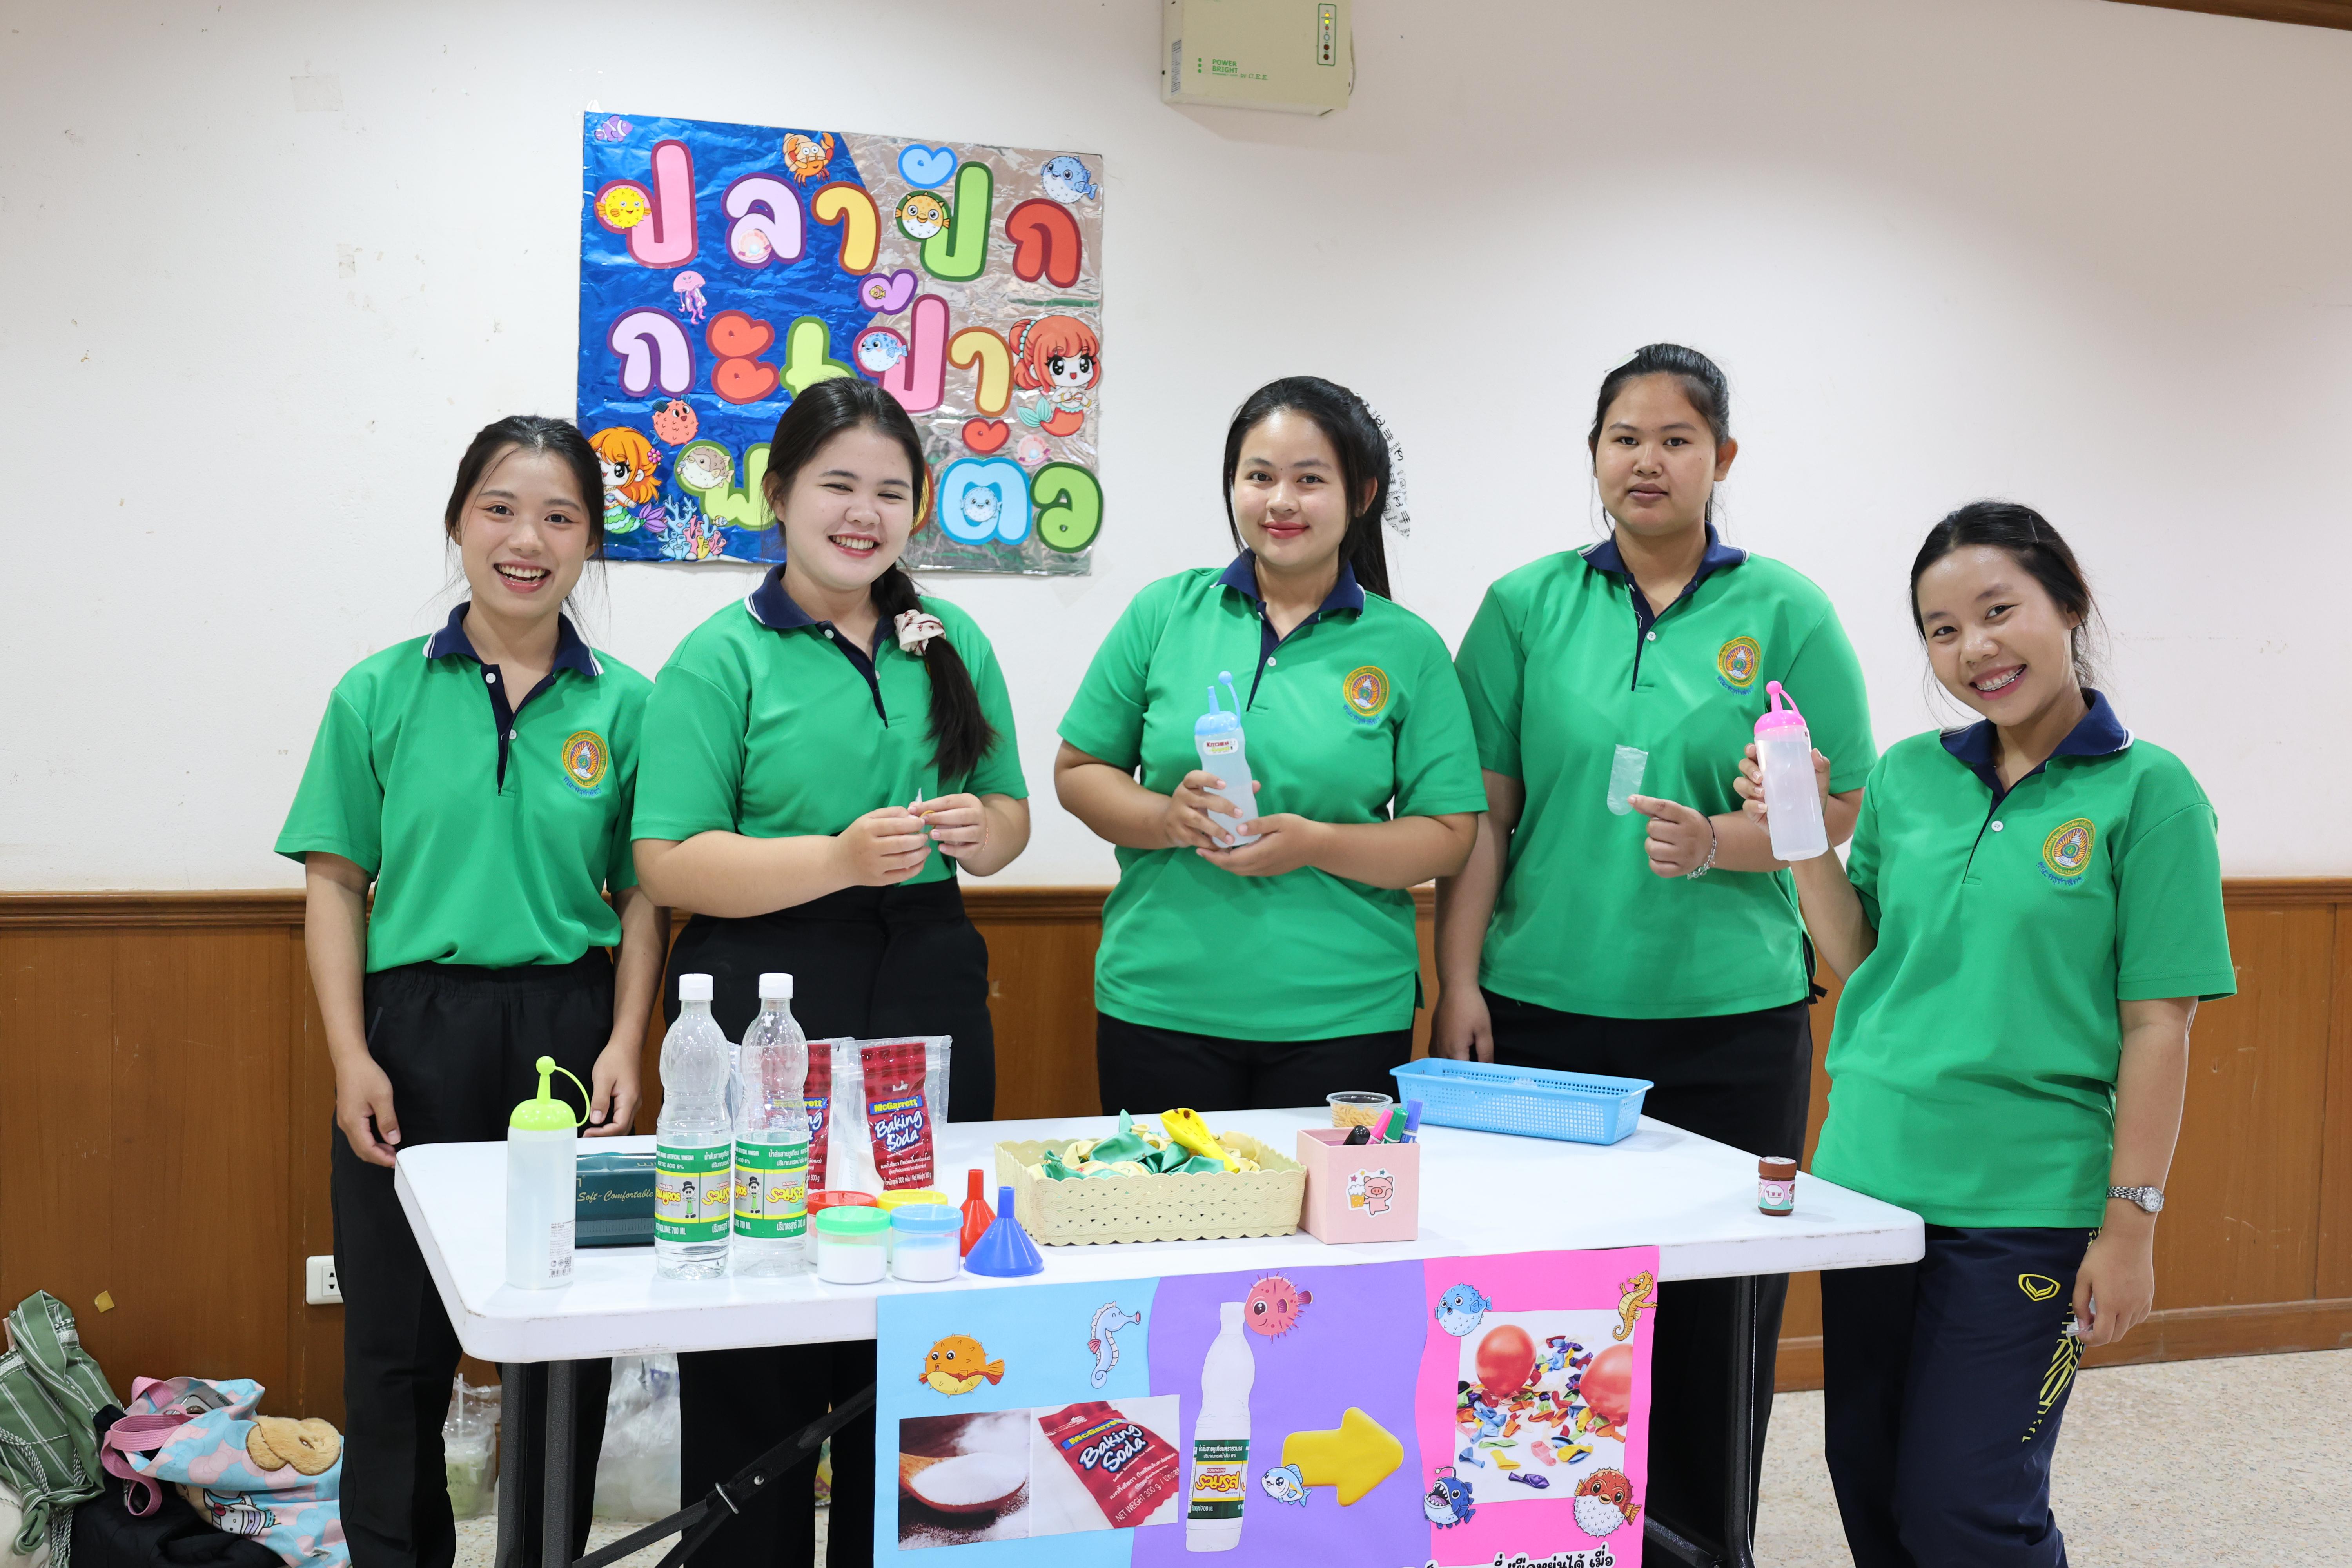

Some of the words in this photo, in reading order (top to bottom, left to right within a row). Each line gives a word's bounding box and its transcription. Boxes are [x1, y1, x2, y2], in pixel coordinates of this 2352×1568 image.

[874, 1098, 918, 1112] McGarrett
[875, 1110, 923, 1139] Baking
[886, 1128, 919, 1151] Soda
[1080, 1425, 1143, 1467] Baking
[1103, 1437, 1146, 1471] Soda
[1195, 1471, 1240, 1492] รวมรส
[1115, 1508, 1127, 1522] NET
[1125, 1494, 1146, 1514] WEIGHT
[1143, 1486, 1156, 1497] 300
[1589, 1544, 1613, 1568] เมื่อ
